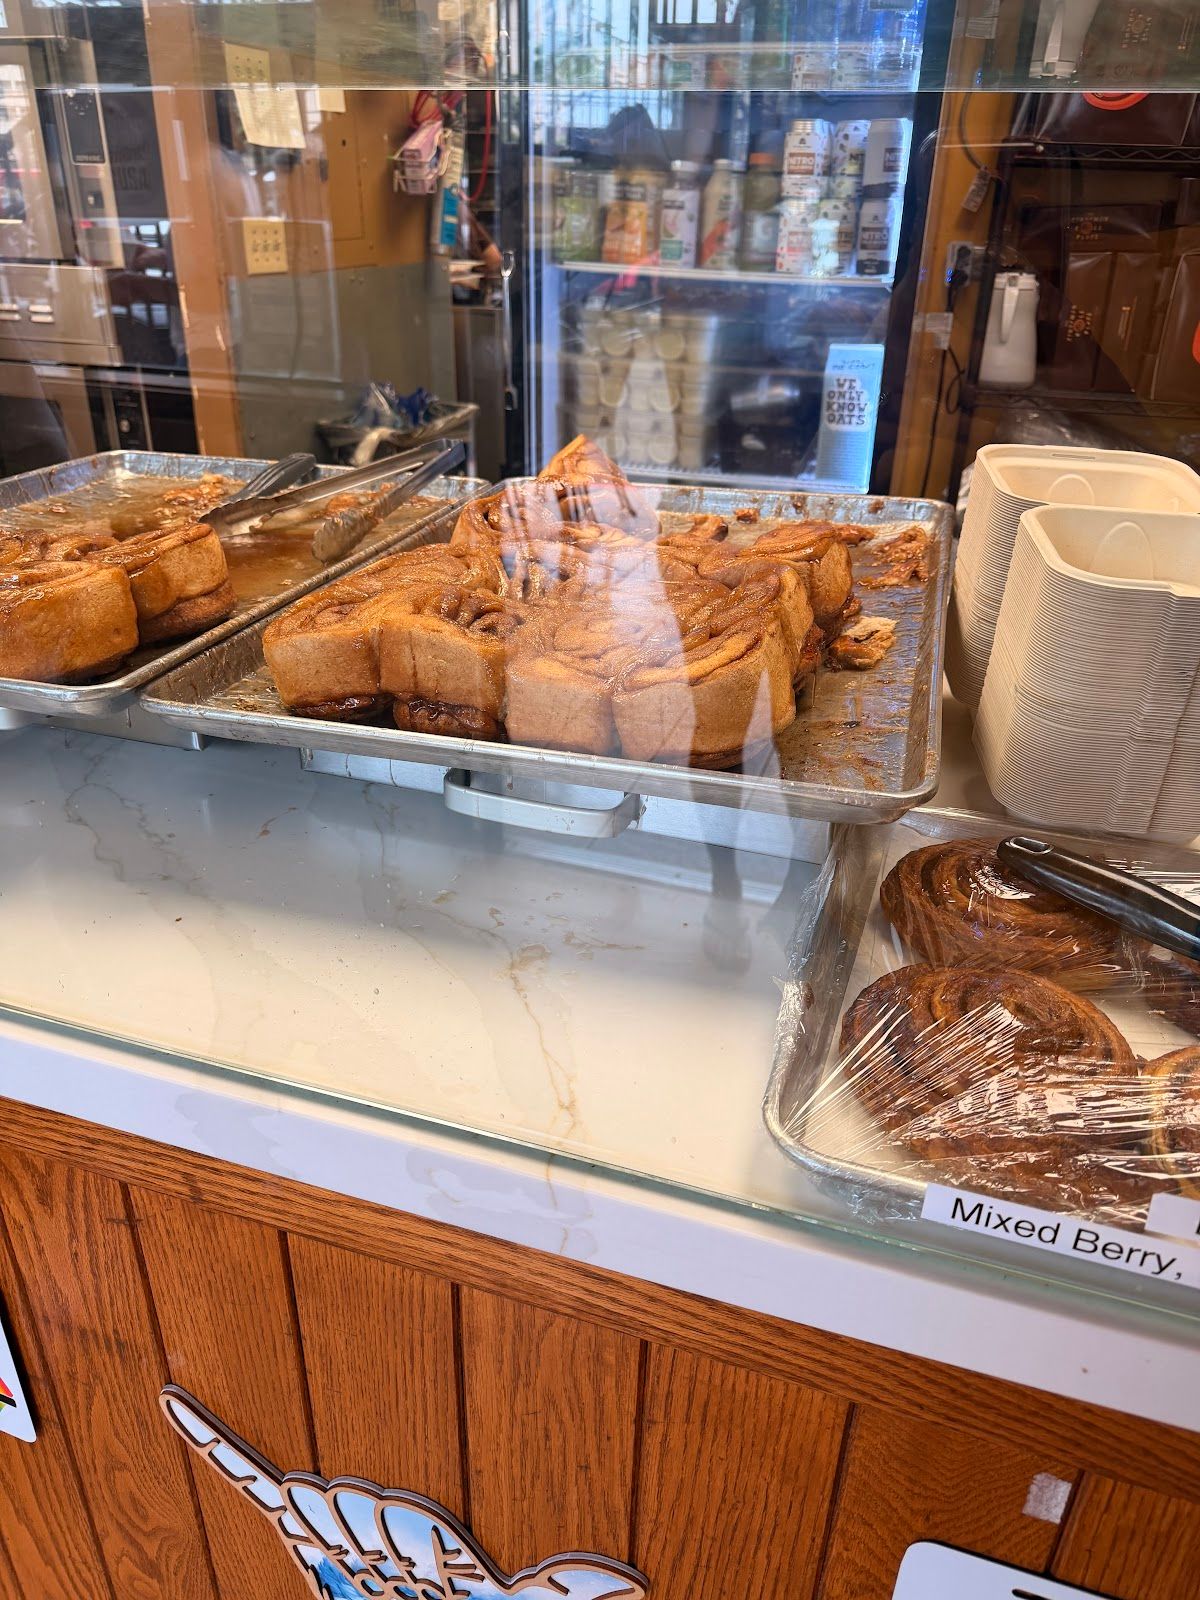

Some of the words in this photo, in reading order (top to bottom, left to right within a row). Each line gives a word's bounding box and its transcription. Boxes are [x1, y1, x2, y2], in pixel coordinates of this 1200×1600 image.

[788, 156, 815, 165] NITRO
[862, 231, 888, 241] NITRO
[836, 378, 857, 390] WE
[828, 390, 863, 401] ONLY
[826, 401, 868, 413] KNOW
[827, 413, 866, 426] OATS
[951, 1198, 1061, 1245] Mixed
[1072, 1228, 1183, 1280] Berry,
